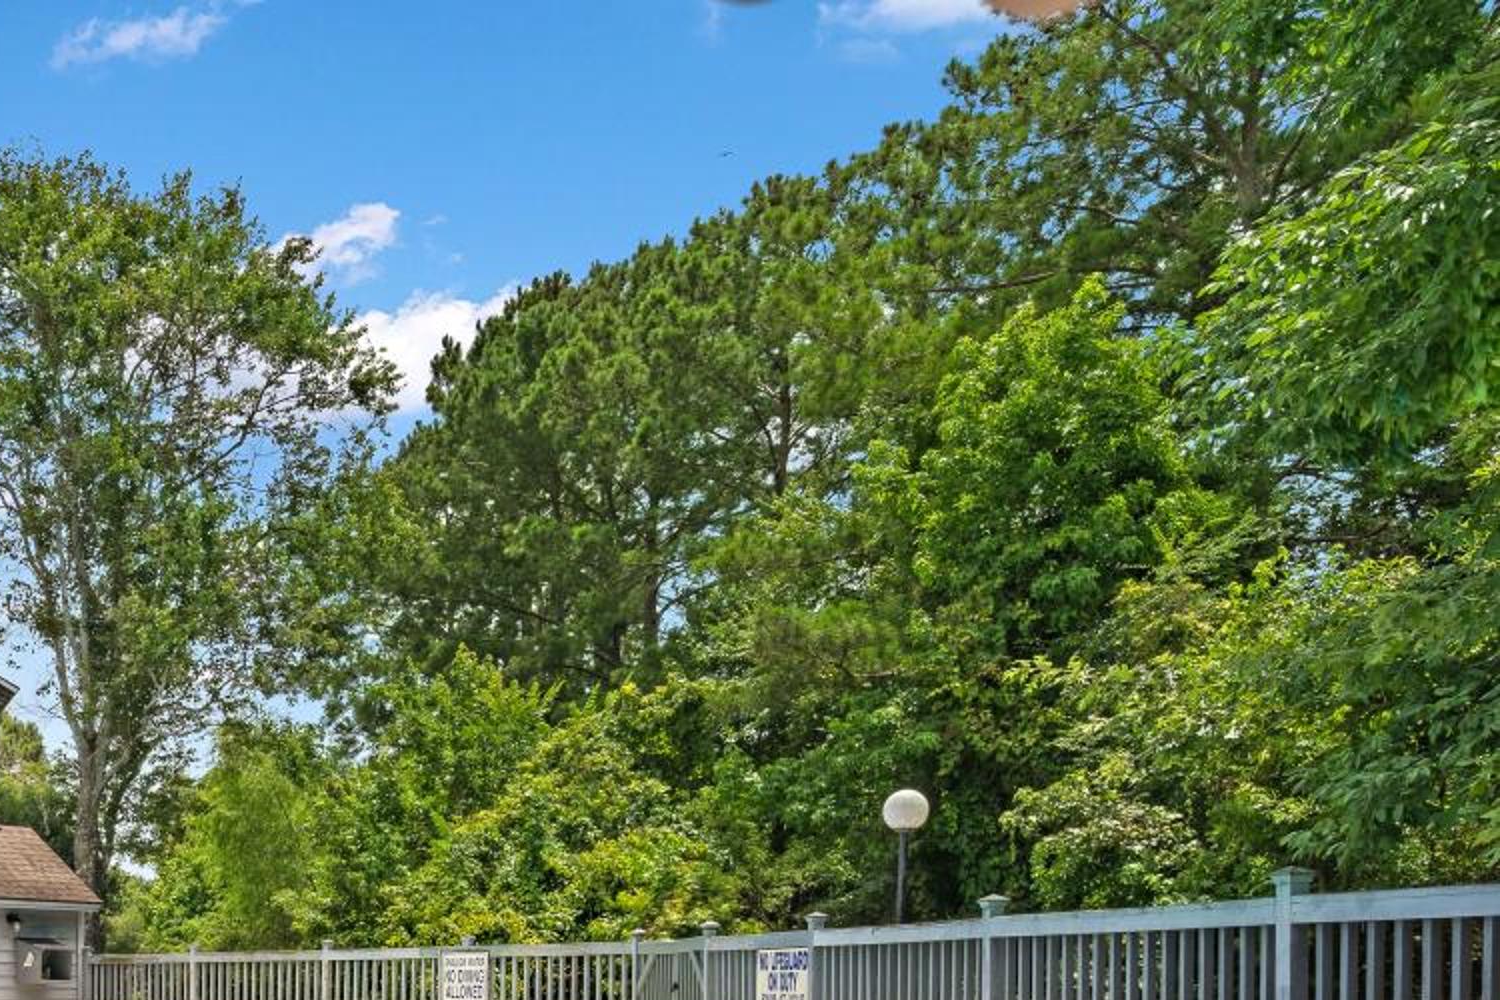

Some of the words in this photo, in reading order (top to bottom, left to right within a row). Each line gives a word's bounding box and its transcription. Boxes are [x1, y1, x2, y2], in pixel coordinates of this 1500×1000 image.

[760, 951, 769, 970] NO
[771, 950, 808, 970] LIFEGUARD
[446, 969, 457, 983] NO
[458, 969, 484, 983] DIVING
[768, 972, 778, 991] ON
[780, 972, 797, 992] DUTY
[446, 984, 483, 999] ALLOWED
